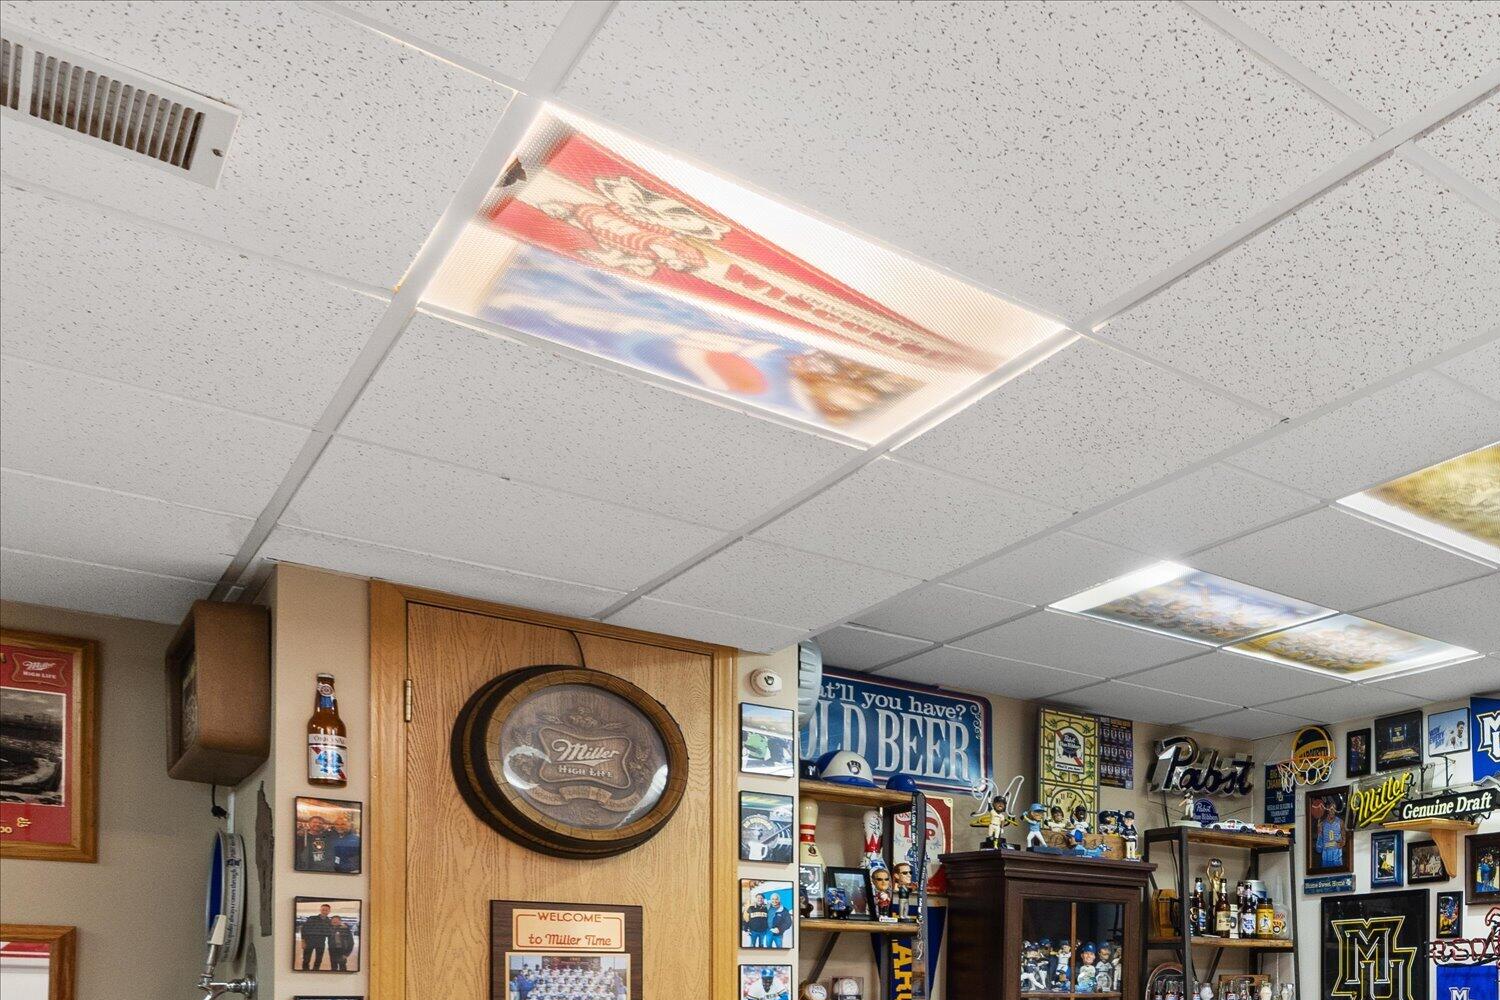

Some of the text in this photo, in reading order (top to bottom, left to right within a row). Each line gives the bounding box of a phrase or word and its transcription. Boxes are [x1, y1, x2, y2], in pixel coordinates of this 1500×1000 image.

[862, 692, 967, 721] you have?
[551, 739, 619, 766] Miller
[874, 708, 971, 782] BEER
[558, 765, 586, 776] HIGH
[1150, 736, 1255, 794] Pabst
[1352, 772, 1410, 823] Miller
[1402, 792, 1493, 820] Genuine Draft
[537, 912, 603, 923] WELCOME
[528, 933, 612, 946] to Miller Time
